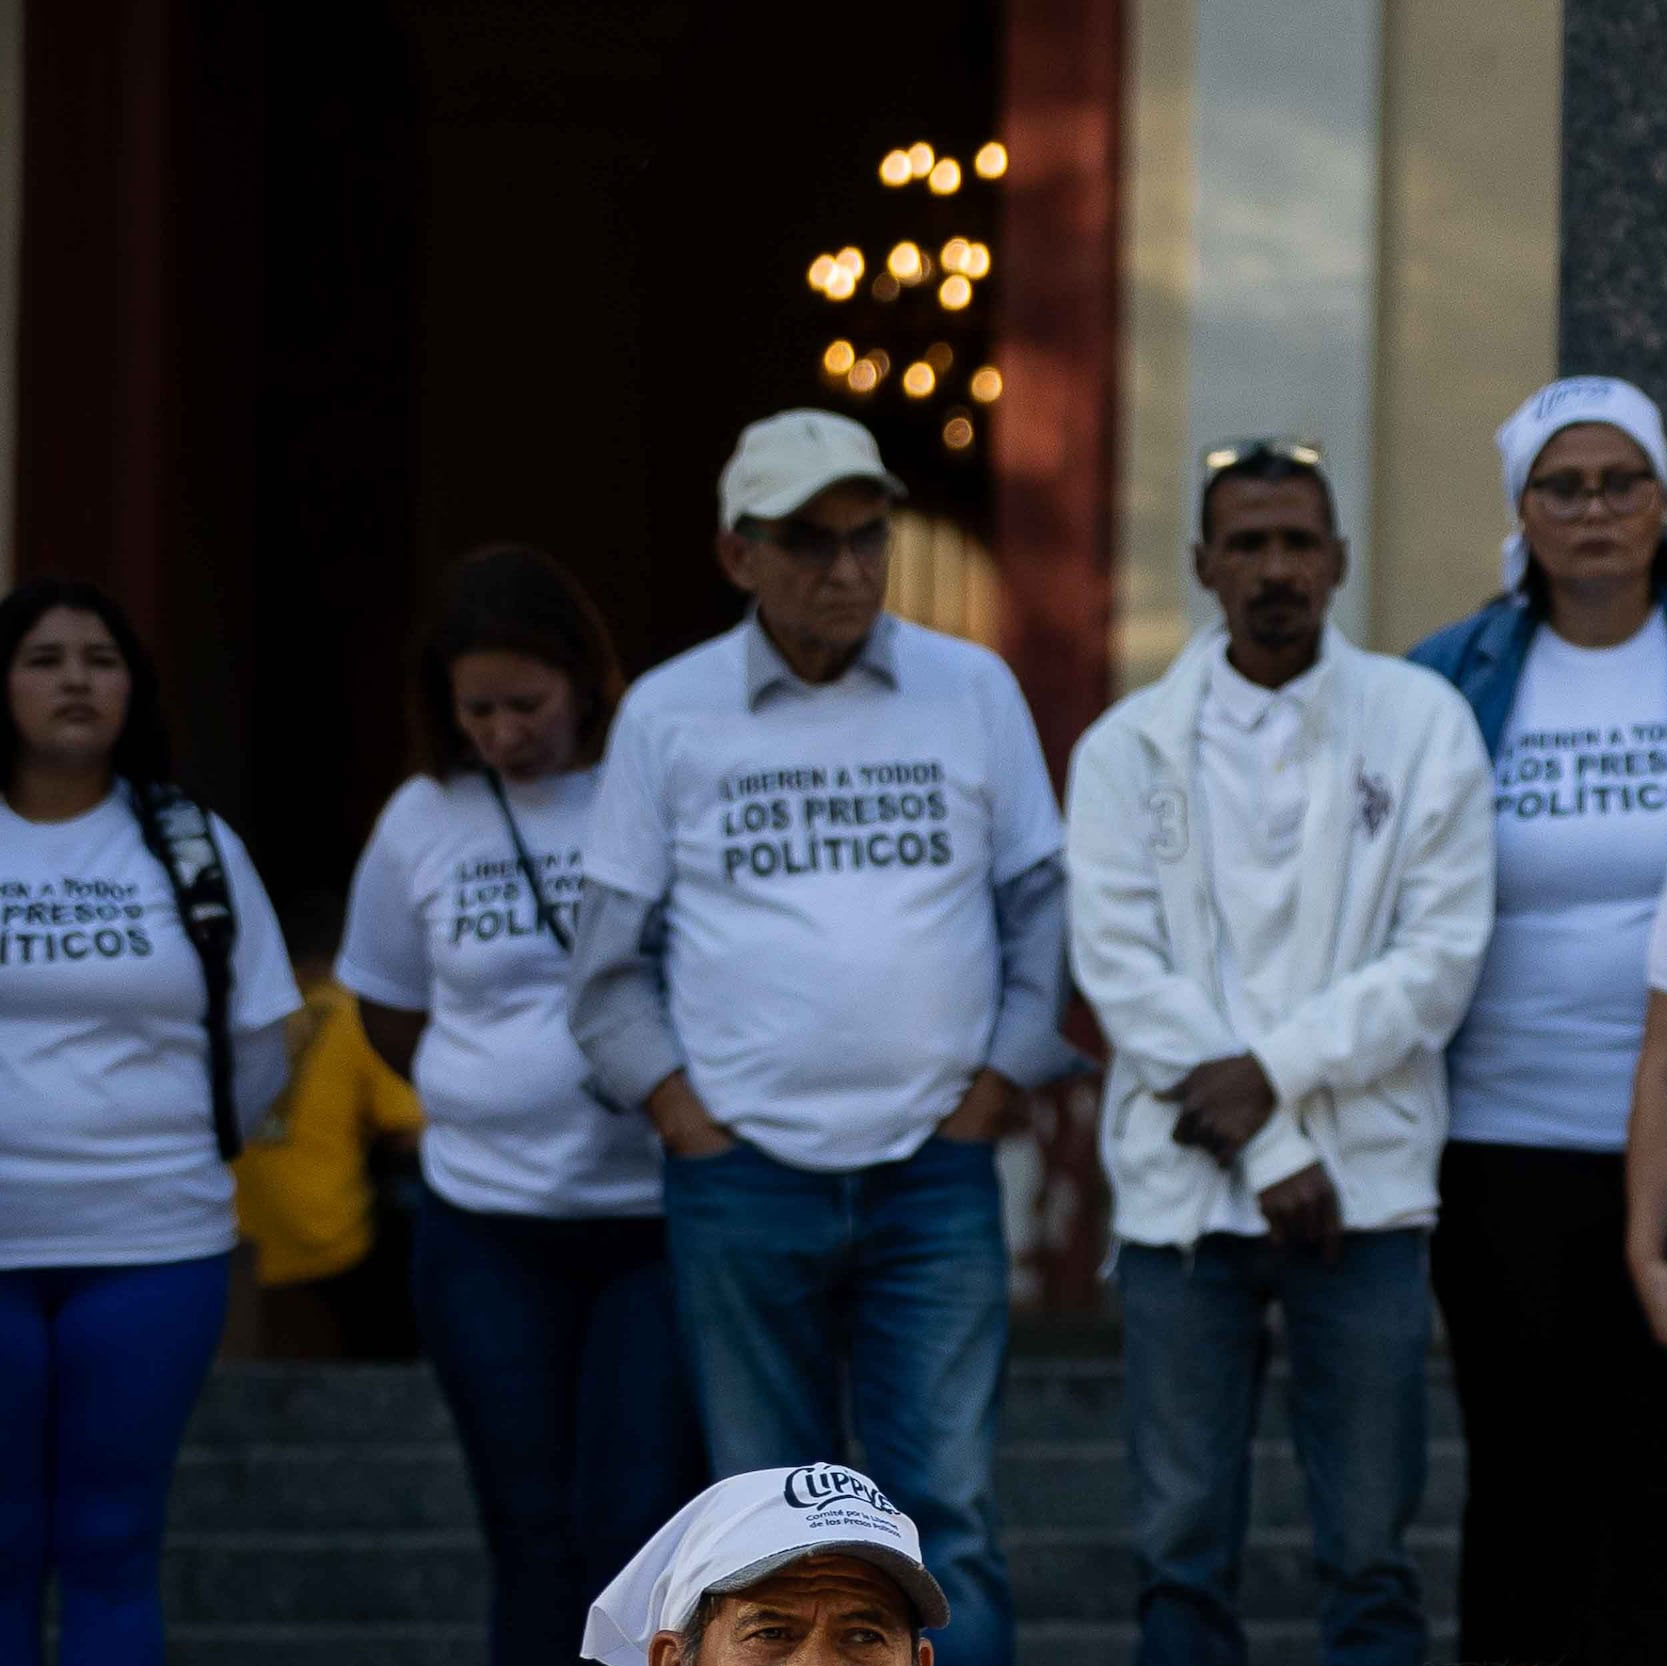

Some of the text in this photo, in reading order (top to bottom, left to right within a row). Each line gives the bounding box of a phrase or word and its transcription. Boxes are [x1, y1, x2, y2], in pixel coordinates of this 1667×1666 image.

[724, 790, 948, 838] LOS PRESOS
[806, 1509, 843, 1522] Comité
[810, 1520, 823, 1529] de
[825, 1518, 842, 1527] los
